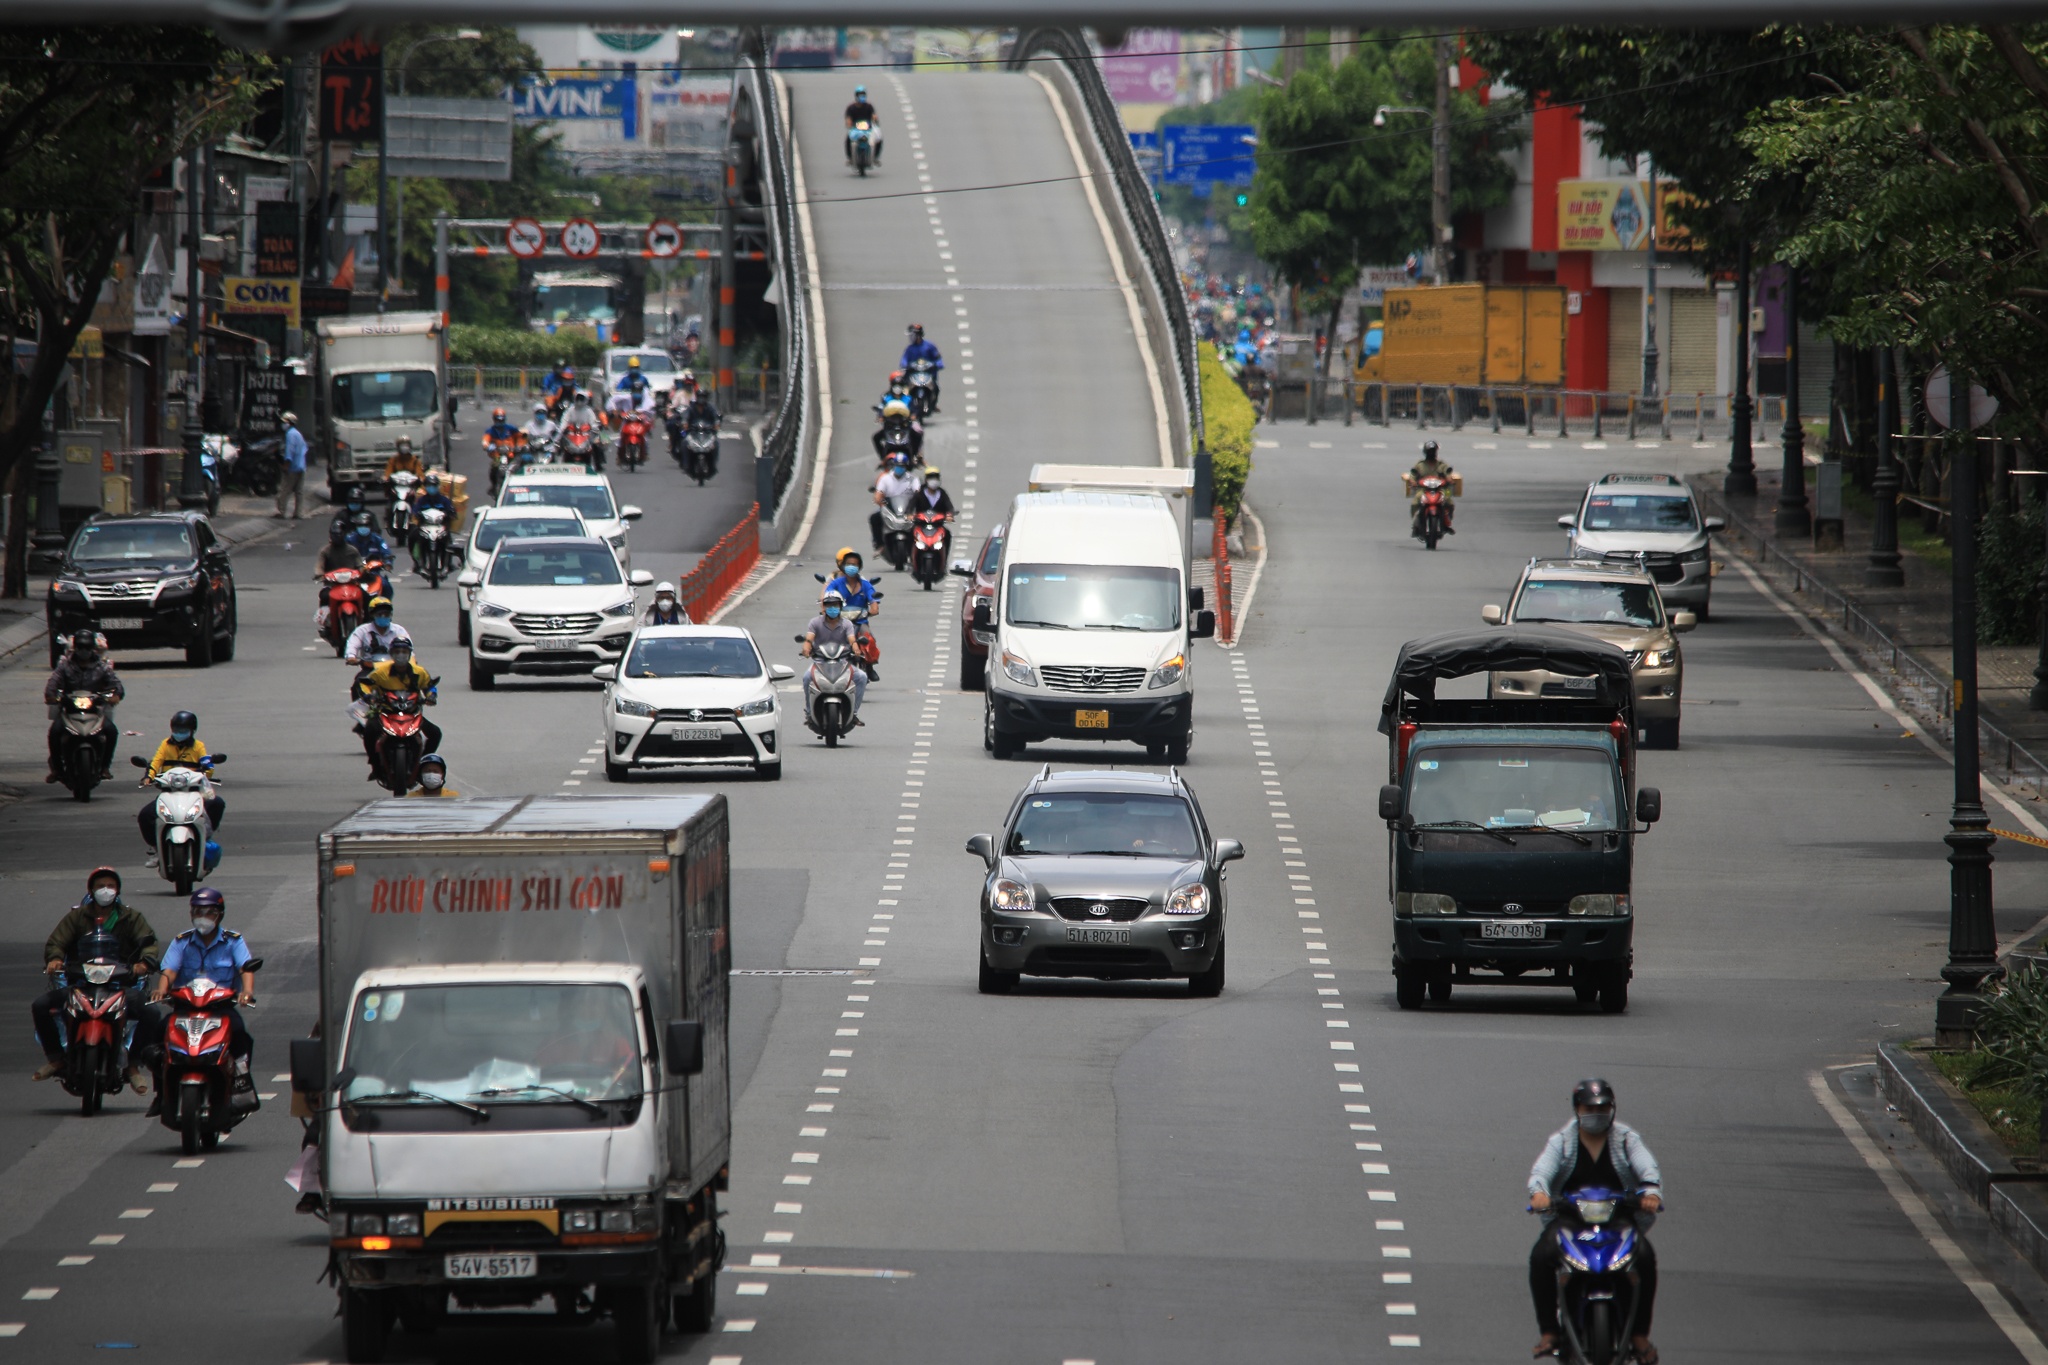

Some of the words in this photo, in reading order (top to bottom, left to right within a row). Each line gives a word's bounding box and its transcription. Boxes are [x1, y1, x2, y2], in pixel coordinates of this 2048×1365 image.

[235, 282, 291, 303] CƠM
[361, 326, 401, 335] ISUZU
[247, 371, 289, 390] HOTEL
[371, 873, 426, 914] BƯU
[432, 872, 513, 914] CHÍNH
[521, 871, 562, 912] SÀI
[570, 869, 624, 911] GÒN
[427, 1199, 555, 1210] MITSUBISHI
